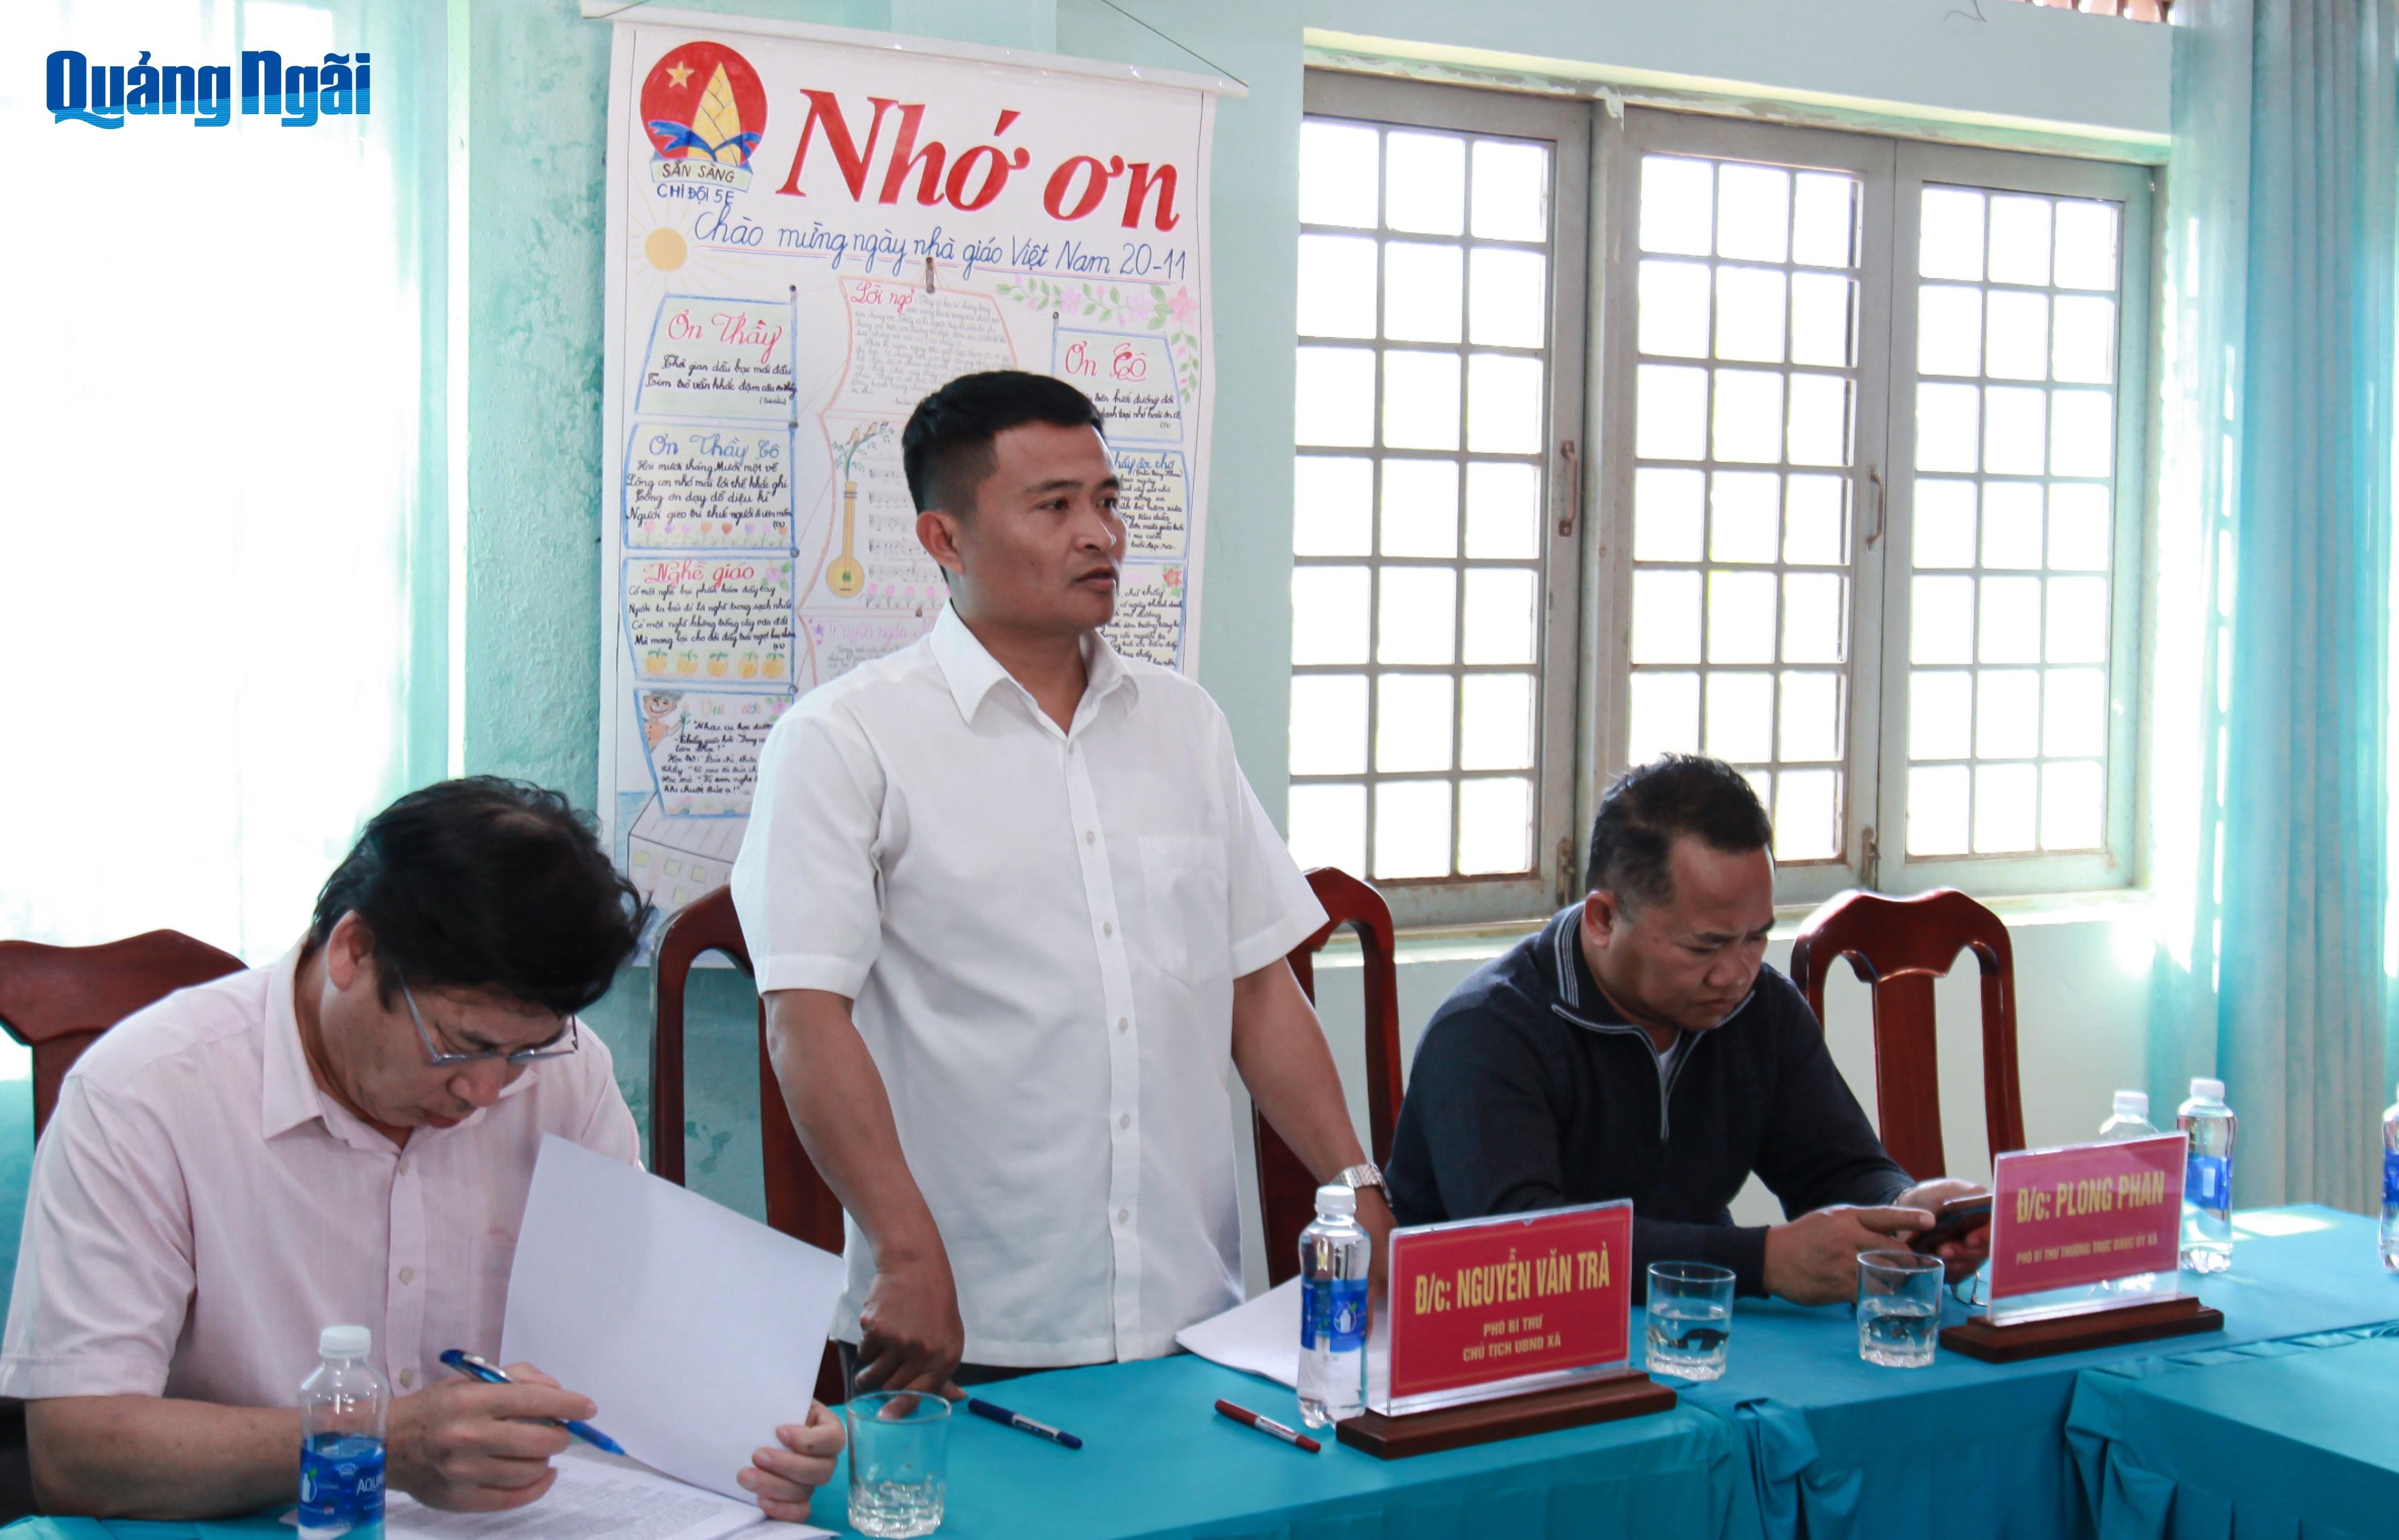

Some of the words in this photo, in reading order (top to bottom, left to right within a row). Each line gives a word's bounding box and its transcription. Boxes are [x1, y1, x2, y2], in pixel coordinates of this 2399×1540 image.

[698, 163, 735, 183] SÀNG
[775, 88, 1032, 212] Nhớ
[1043, 153, 1182, 231] ơn
[688, 186, 709, 205] ĐỘI
[713, 189, 734, 205] 5E
[695, 202, 764, 246] Chào
[778, 221, 848, 269] mừng
[853, 229, 907, 276] ngày
[914, 226, 955, 259] nhà
[963, 237, 1002, 281] giáo
[1012, 235, 1049, 271] Việt
[1056, 241, 1110, 274] Nam
[1119, 242, 1186, 280] 20-11
[711, 312, 783, 364] Thầy
[689, 433, 749, 467] Thầy
[1114, 451, 1135, 475] hầy
[643, 558, 708, 589] Nghề
[712, 561, 755, 589] giáo
[2056, 1177, 2114, 1218] PLONG
[2118, 1170, 2165, 1210] PHAN
[1415, 1273, 1451, 1315] Đ/c:
[1457, 1248, 1531, 1309] NGUYỄN
[1536, 1248, 1572, 1297] VĂN
[1577, 1241, 1610, 1291] TRÀ
[1484, 1319, 1505, 1337] PHÓ
[1508, 1317, 1520, 1333] BÍ
[1523, 1314, 1544, 1331] THƯ
[1463, 1341, 1485, 1362] CHỦ
[1488, 1341, 1512, 1361] TỊCH
[1515, 1336, 1544, 1354] UBND
[1547, 1332, 1561, 1348] XÃ
